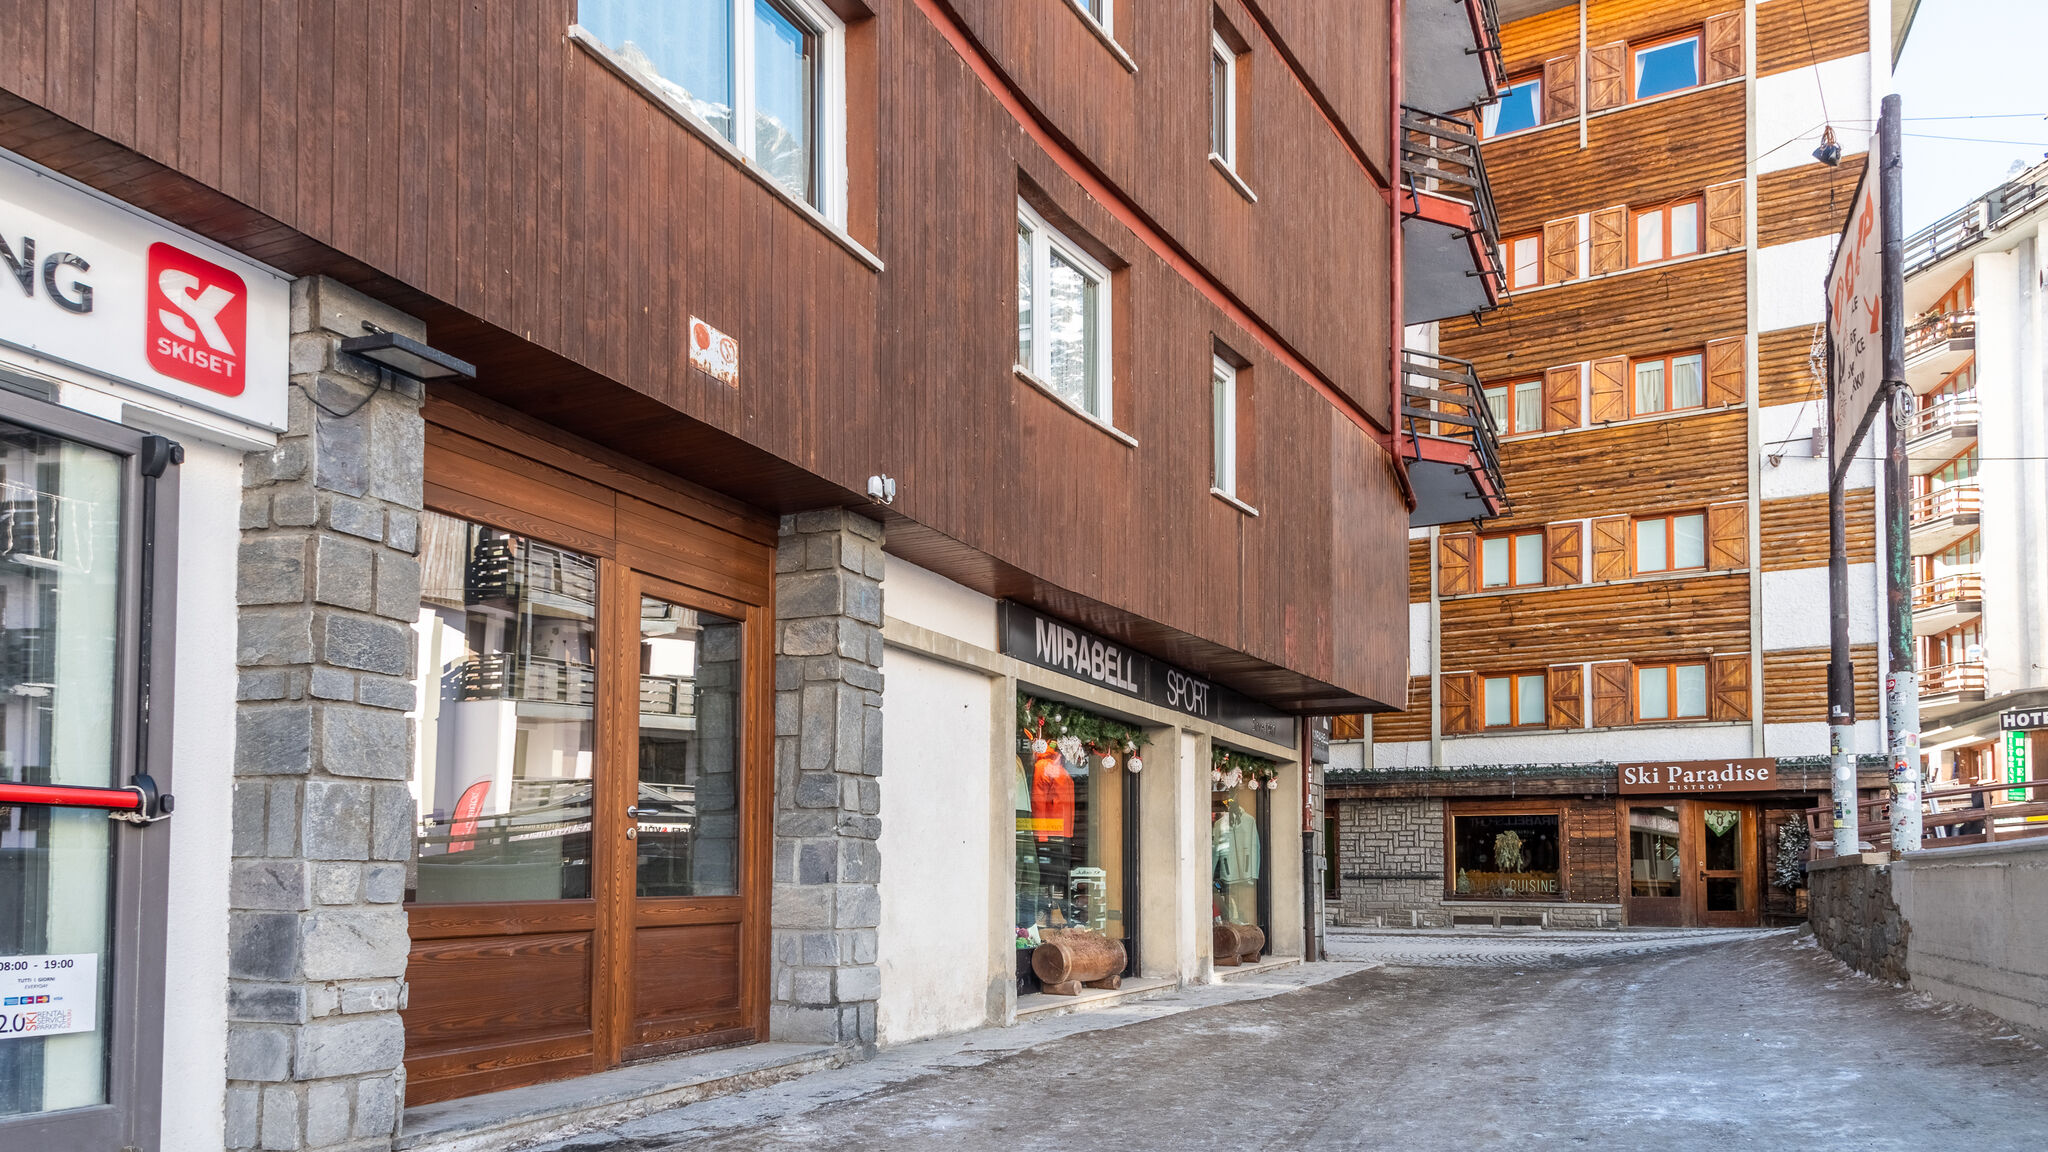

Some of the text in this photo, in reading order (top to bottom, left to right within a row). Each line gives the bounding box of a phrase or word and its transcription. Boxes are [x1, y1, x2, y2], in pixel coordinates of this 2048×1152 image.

[158, 337, 236, 378] SKISET
[1035, 617, 1210, 716] MIRABELL SPORT
[1624, 762, 1769, 785] Ski Paradise
[1669, 783, 1723, 791] BISTROT
[1509, 879, 1556, 893] CUISINE
[44, 959, 74, 969] 19:00
[25, 1011, 38, 1031] SKI
